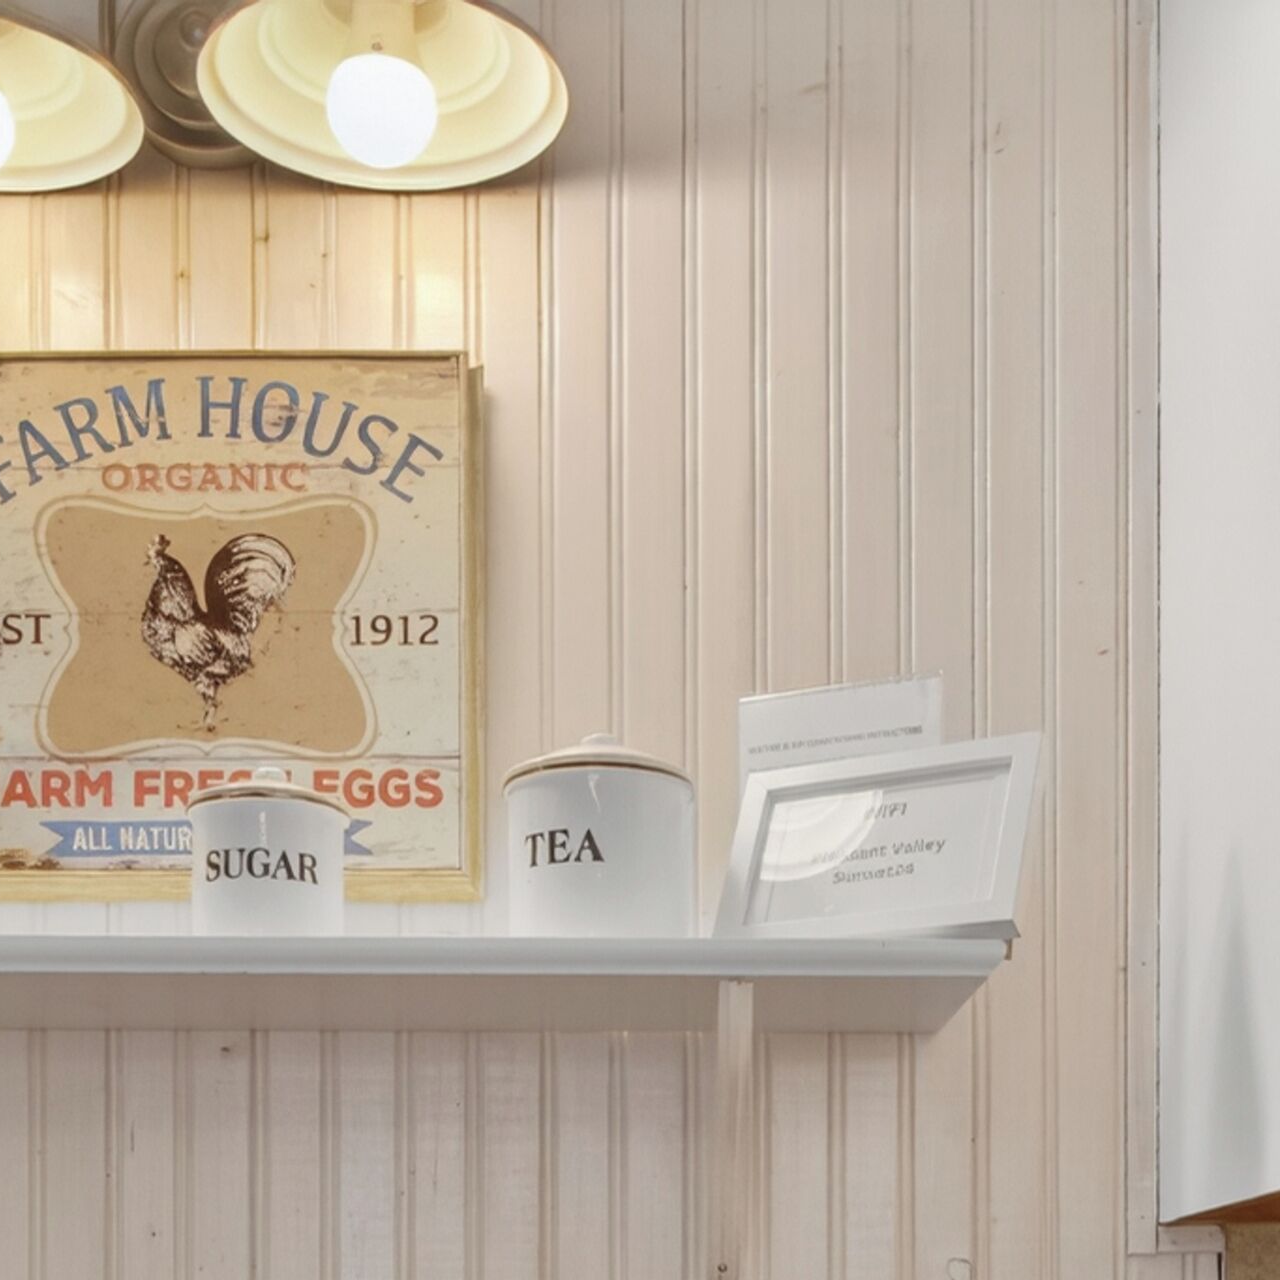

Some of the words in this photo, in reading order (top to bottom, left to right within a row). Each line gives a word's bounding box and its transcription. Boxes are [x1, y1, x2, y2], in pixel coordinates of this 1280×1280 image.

[196, 376, 444, 503] HOUSE
[101, 463, 308, 492] ORGANIC
[349, 614, 439, 646] 1912
[313, 769, 443, 808] EGGS
[72, 827, 112, 850] ALL
[120, 826, 192, 851] NATUR
[525, 828, 604, 867] TEA
[893, 839, 946, 854] Valley
[206, 847, 317, 884] SUGAR
